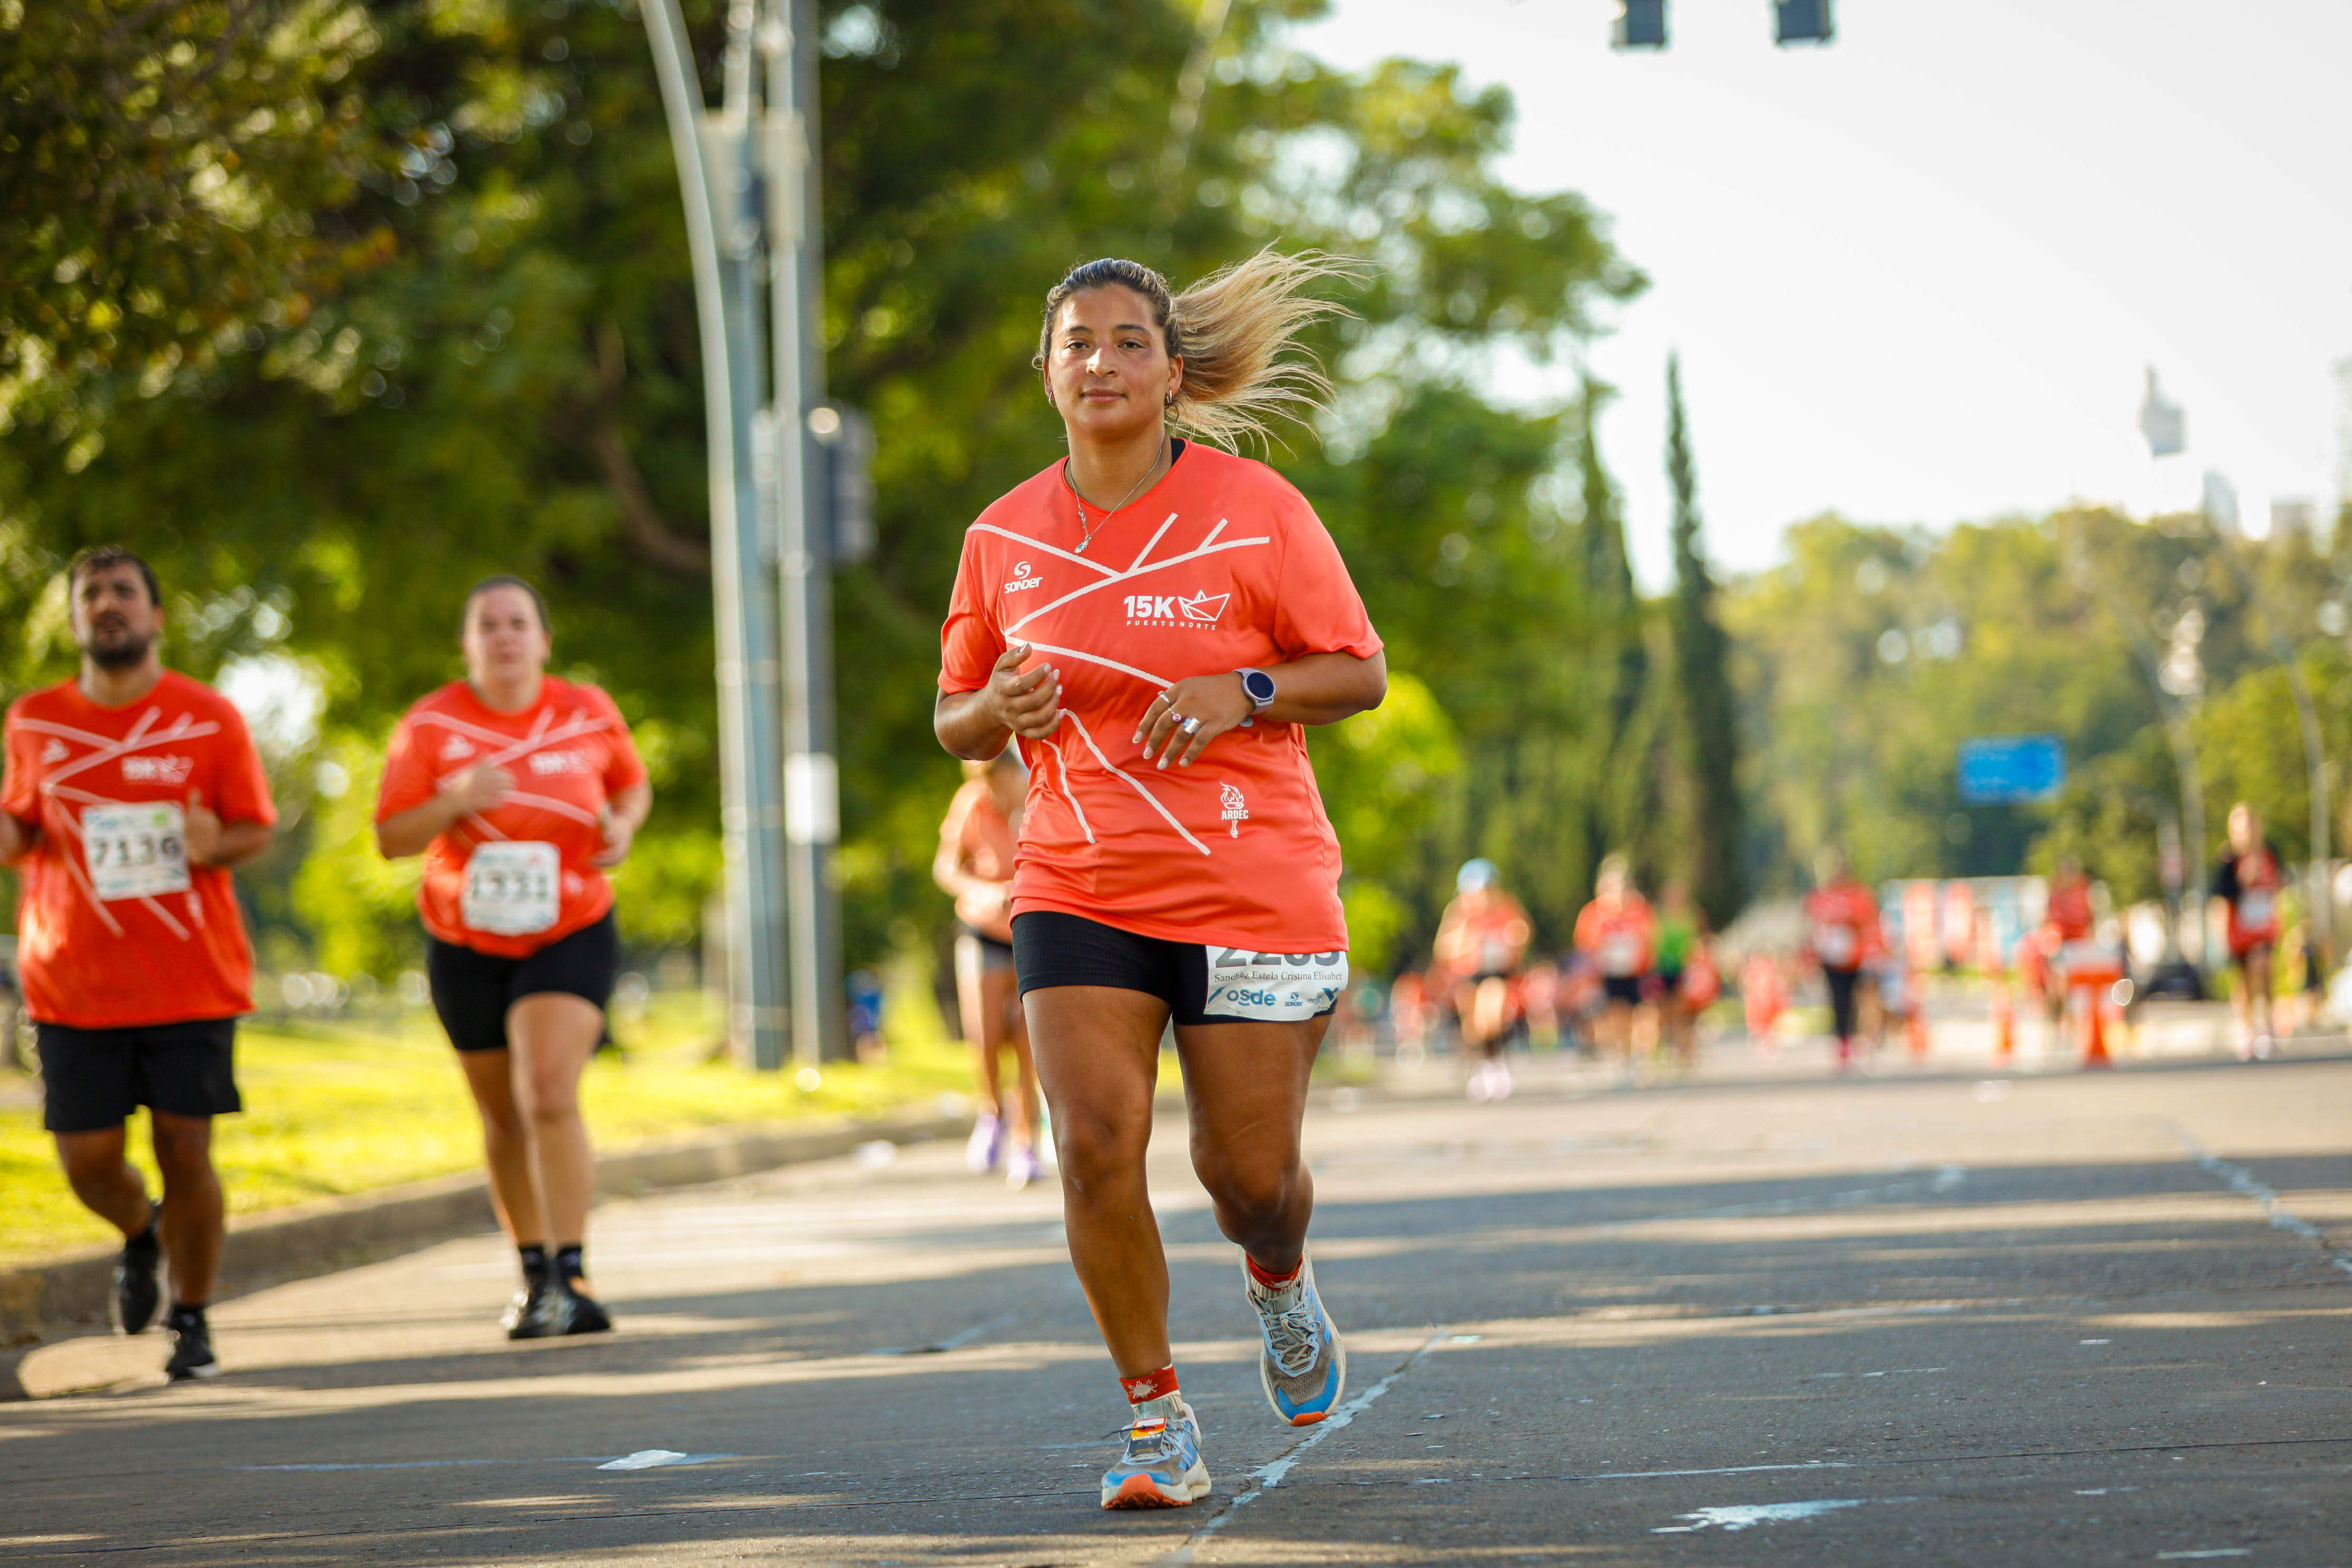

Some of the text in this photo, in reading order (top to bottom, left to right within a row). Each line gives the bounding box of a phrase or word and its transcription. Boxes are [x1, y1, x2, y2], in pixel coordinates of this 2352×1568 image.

[1124, 595, 1176, 618] 15K
[1180, 621, 1216, 630] NORTE
[1221, 809, 1249, 820] ARDEC
[1214, 971, 1342, 982] Sanchez Estela Cristina Elisabet
[1227, 989, 1276, 1006] osde
